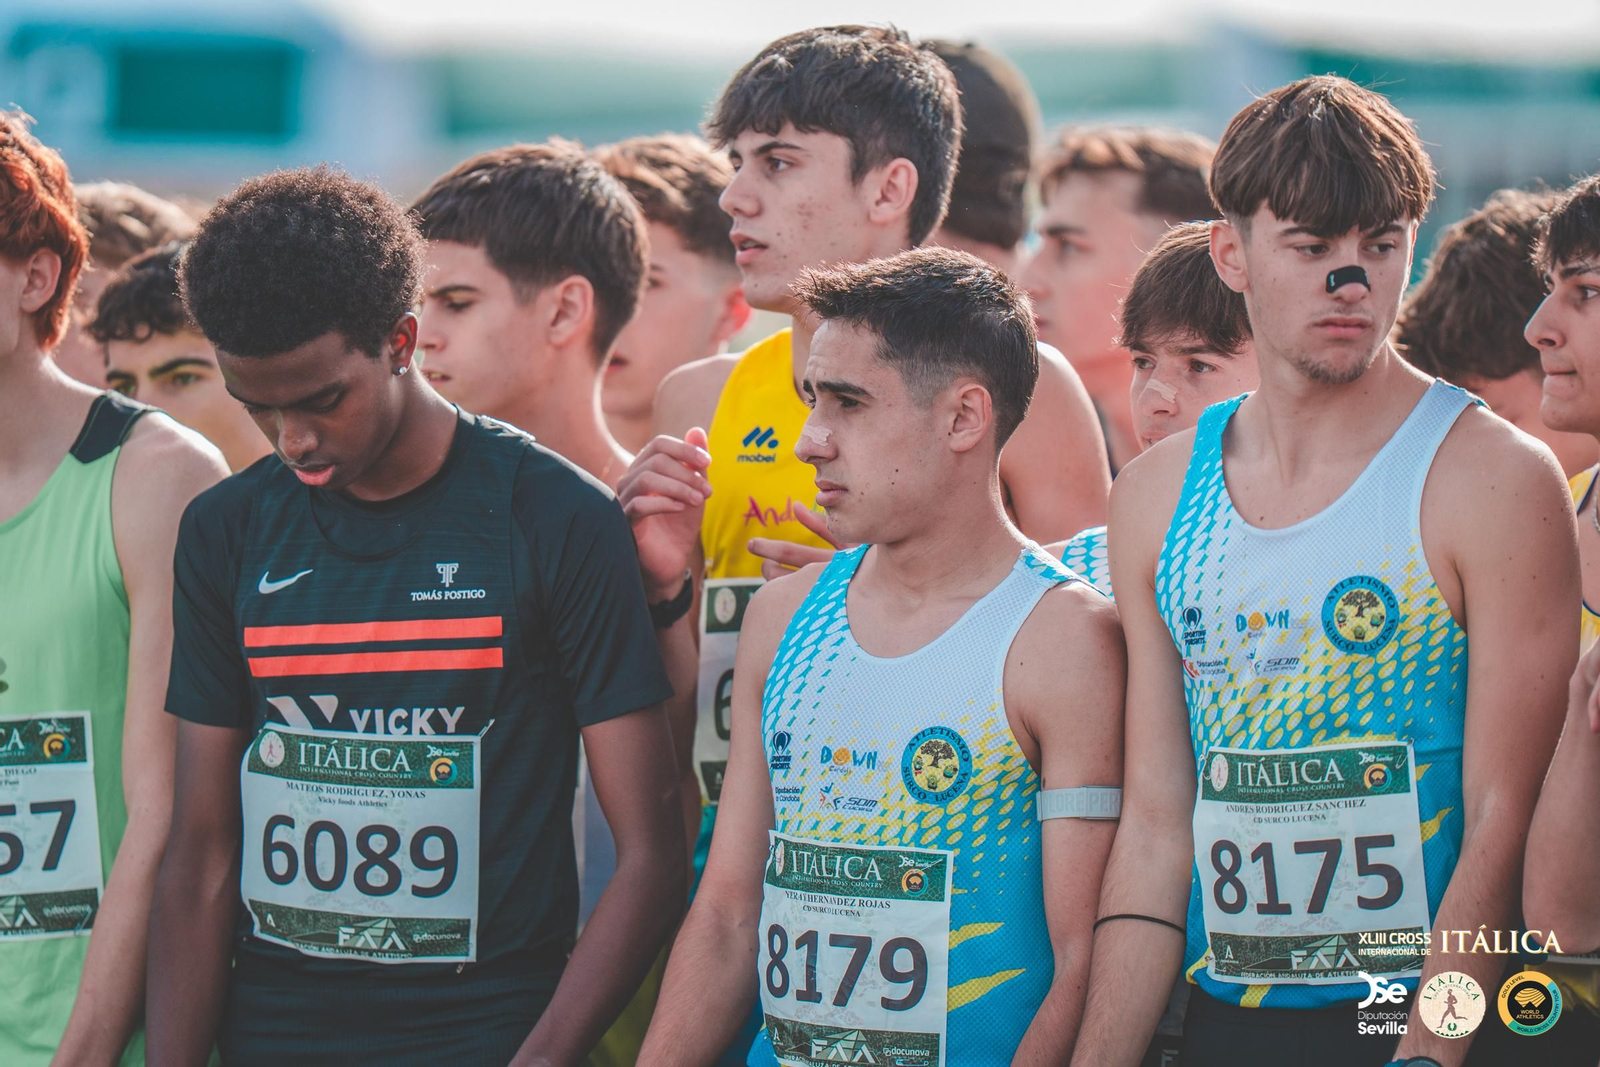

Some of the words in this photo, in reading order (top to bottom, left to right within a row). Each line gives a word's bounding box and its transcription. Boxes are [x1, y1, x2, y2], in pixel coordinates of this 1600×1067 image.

[411, 590, 443, 601] TOMÁS
[444, 589, 486, 600] POSTIGO
[1328, 576, 1396, 609] ATLETISMO
[1236, 609, 1289, 632] DOWN
[1325, 620, 1355, 651] SURCO
[1364, 619, 1396, 652] LUCENA
[349, 706, 466, 736] VICKY
[299, 739, 412, 772] ITÁLICA
[909, 727, 970, 762] ATLETISMO
[820, 745, 878, 771] DOWN
[300, 766, 352, 777] INTERNATIONAL
[354, 770, 377, 778] CROSS
[903, 766, 927, 800] SURCO
[935, 772, 969, 802] LUCENA
[1237, 757, 1345, 787] ITÁLICA
[286, 781, 324, 793] MATEOS
[326, 784, 388, 799] RODRÍGUEZ,
[391, 790, 426, 799] YONAS
[1237, 784, 1285, 794] INTERNATIONAL
[1286, 785, 1309, 793] CROSS
[1311, 782, 1346, 791] COUNTRY
[318, 796, 336, 806] Vicky
[338, 798, 356, 806] foods
[357, 800, 388, 808] Athletics
[1225, 805, 1254, 814] ANDRES
[1256, 803, 1314, 814] RODRIGUEZ
[1315, 799, 1366, 810] SANCHEZ
[1253, 816, 1263, 824] CD
[1264, 816, 1290, 824] SURCO
[1292, 814, 1326, 823] LUCENA
[262, 814, 459, 899] 6089
[791, 848, 883, 881] ITÁLICA
[850, 881, 883, 889] COUNTRY
[1211, 834, 1404, 915] 8175
[785, 890, 806, 902] YERAY
[858, 898, 891, 909] ROJAS
[766, 924, 928, 1011] 8179
[891, 1045, 930, 1057] docunova
